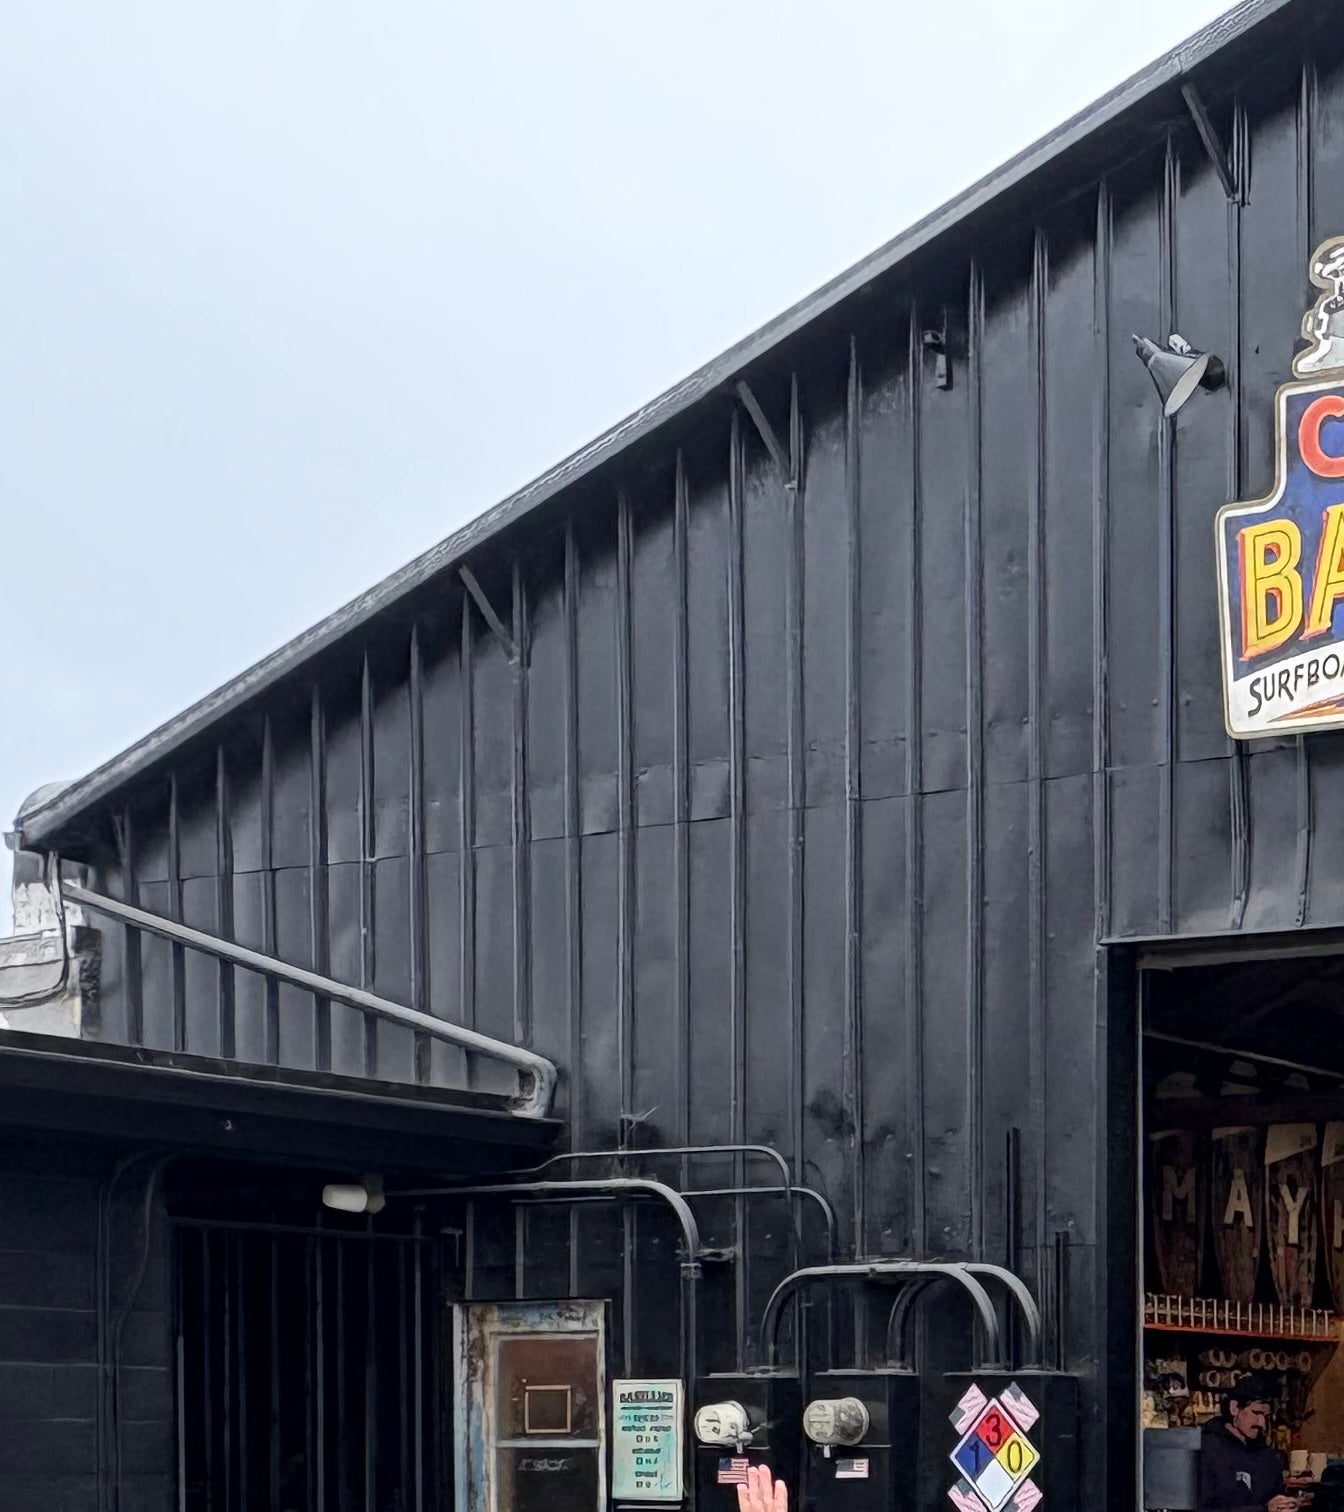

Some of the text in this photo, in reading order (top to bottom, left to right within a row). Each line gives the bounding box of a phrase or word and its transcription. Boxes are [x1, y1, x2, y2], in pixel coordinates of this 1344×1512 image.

[985, 1413, 1001, 1447] 3
[969, 1440, 1022, 1474] 1 0
